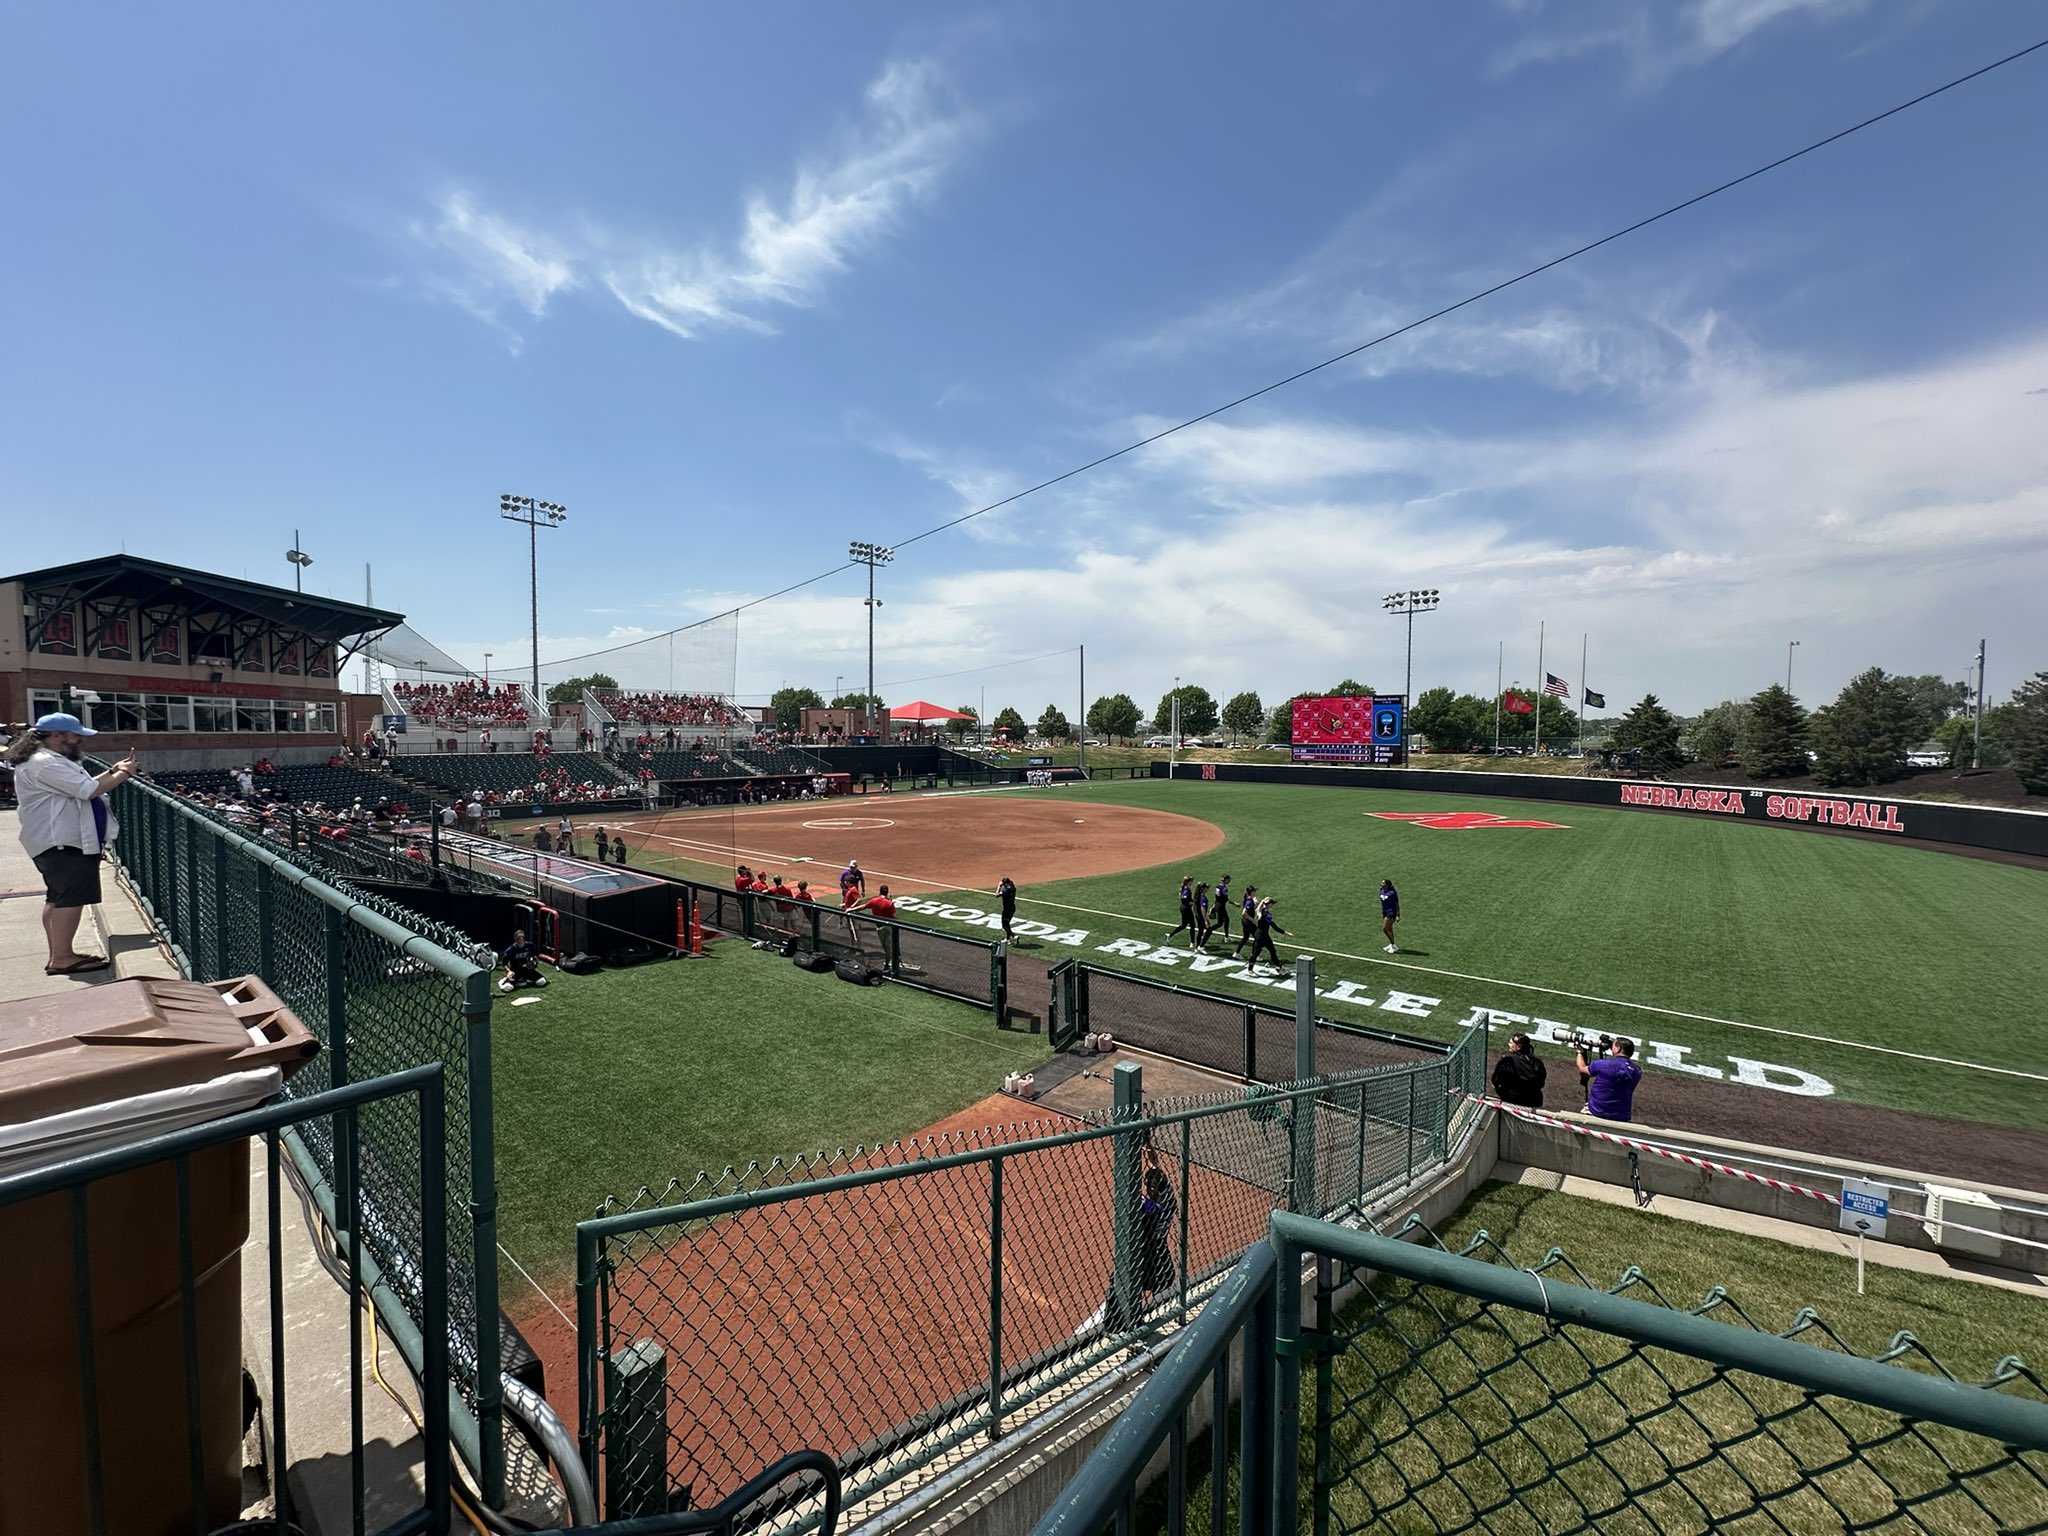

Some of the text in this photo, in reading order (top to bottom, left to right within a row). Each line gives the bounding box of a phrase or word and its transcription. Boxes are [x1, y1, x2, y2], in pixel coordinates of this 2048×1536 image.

[1202, 764, 1216, 780] N
[1749, 790, 1763, 798] 225
[1621, 785, 1905, 833] NEBRASKA SOFTBALL
[892, 895, 1090, 948] RHONDA
[1457, 1006, 1836, 1098] FIELD
[1847, 1192, 1884, 1207] RESTRICTED
[1852, 1201, 1877, 1212] ACCESS
